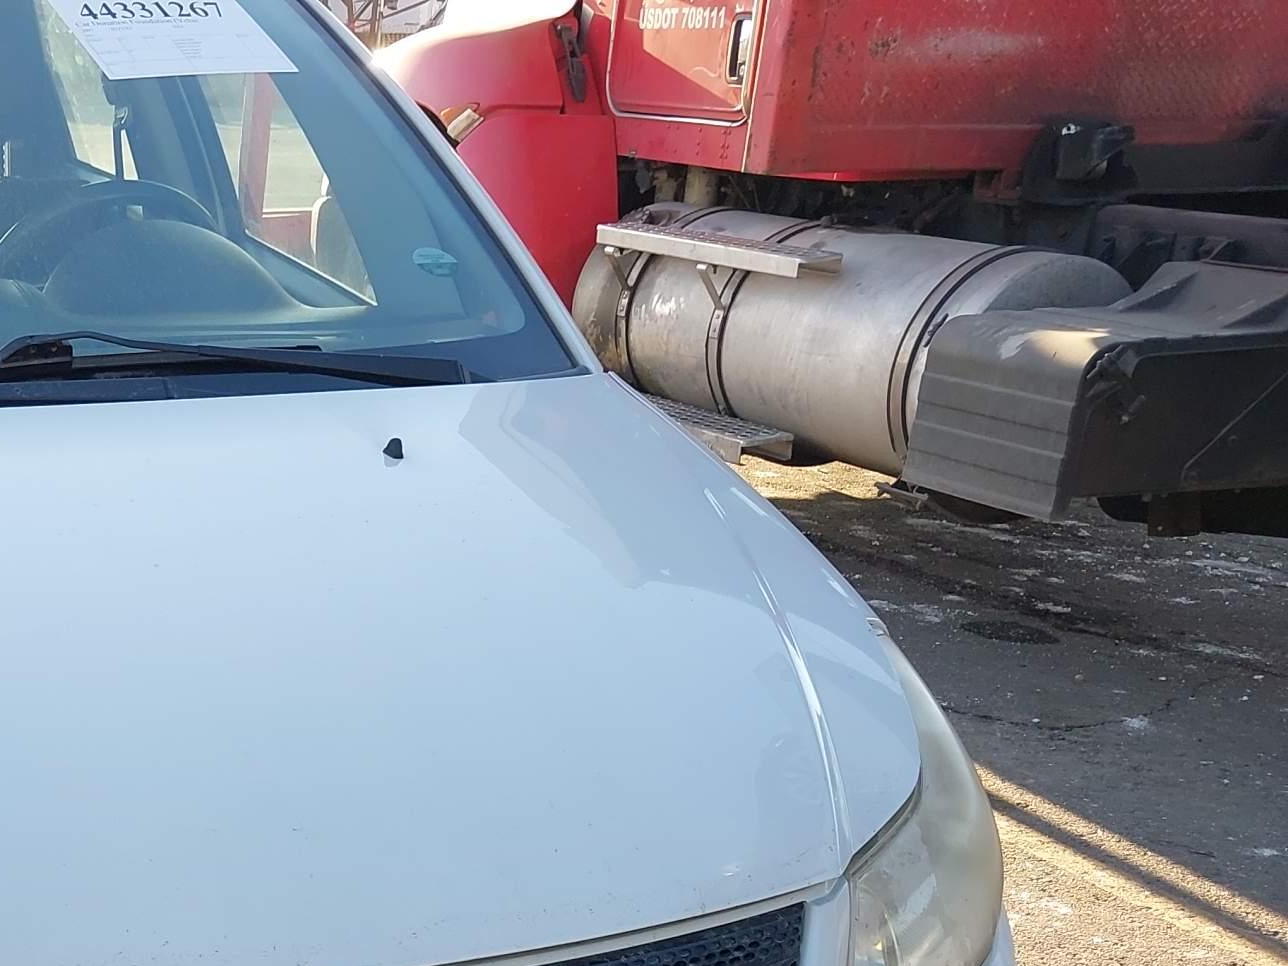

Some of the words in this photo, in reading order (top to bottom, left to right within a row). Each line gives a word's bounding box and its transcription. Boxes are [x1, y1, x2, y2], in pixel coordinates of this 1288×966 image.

[80, 1, 222, 19] 44331267
[639, 7, 679, 29] USDOT
[681, 6, 726, 29] 708111
